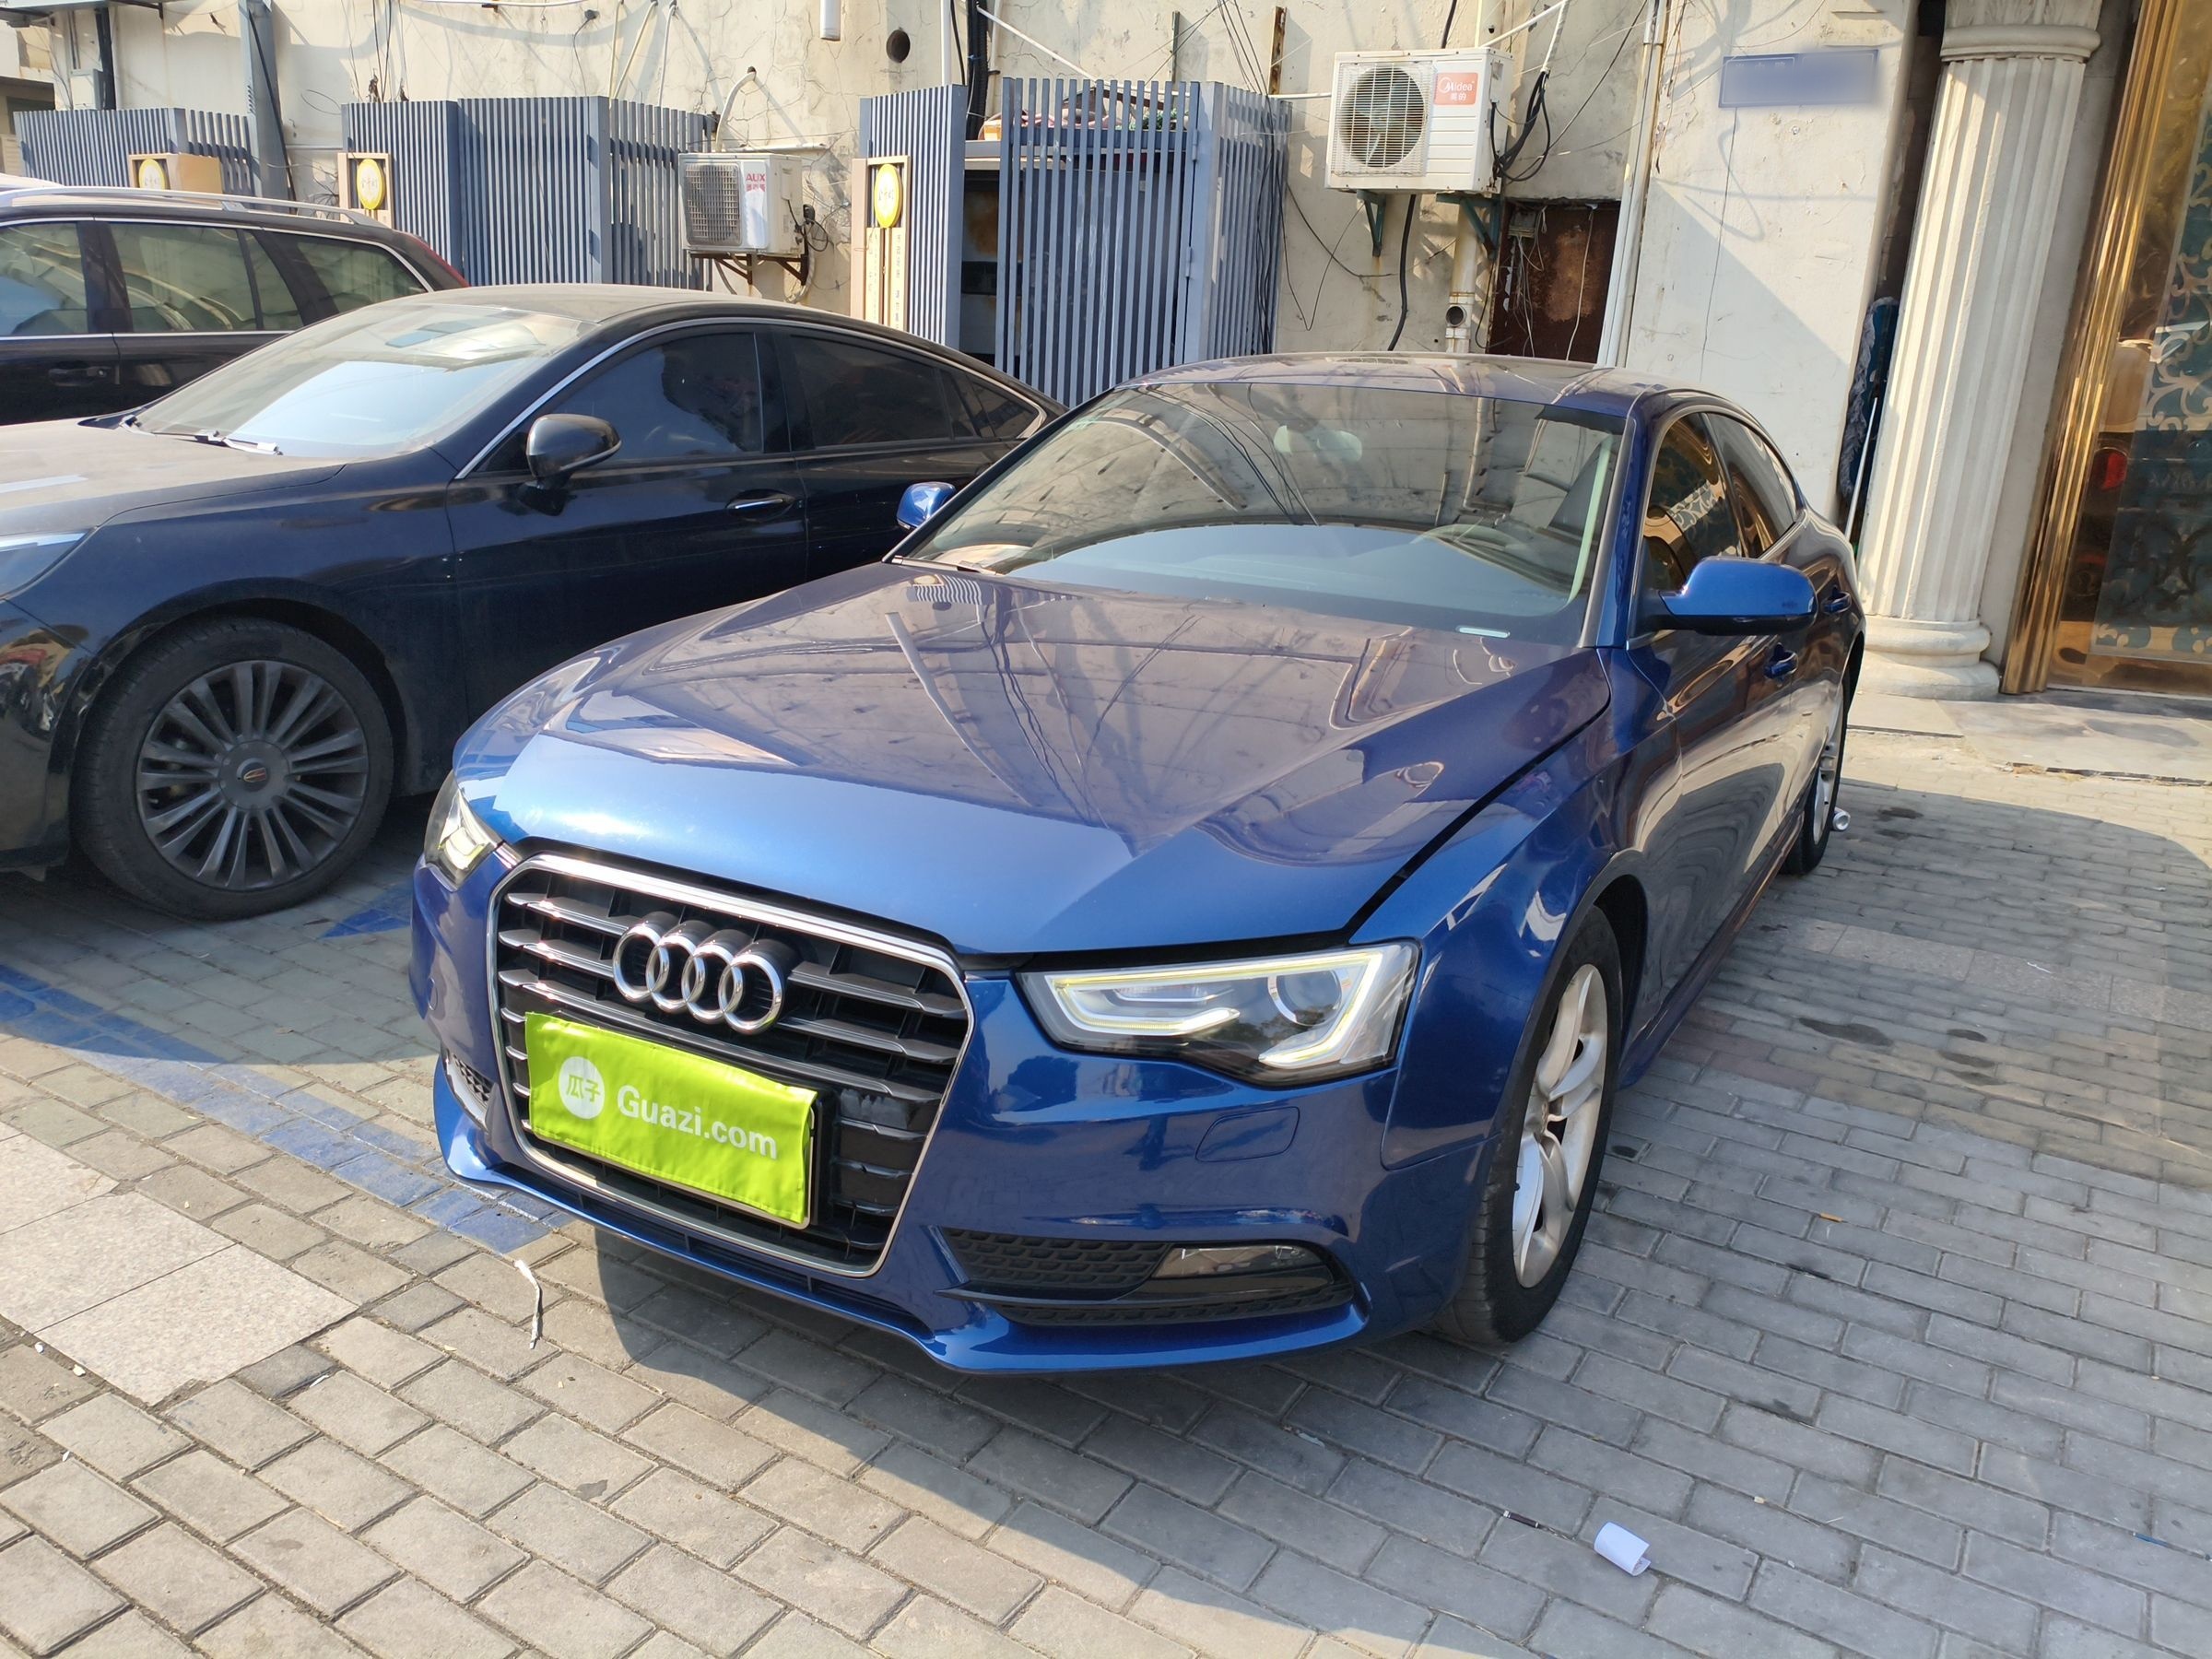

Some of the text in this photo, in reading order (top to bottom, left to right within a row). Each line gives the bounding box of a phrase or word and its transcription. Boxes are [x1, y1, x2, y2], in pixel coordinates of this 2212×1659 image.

[1438, 78, 1473, 92] Midea
[746, 173, 765, 182] AUX
[566, 1075, 601, 1103] 瓜子
[617, 1085, 778, 1160] Guazi.com
